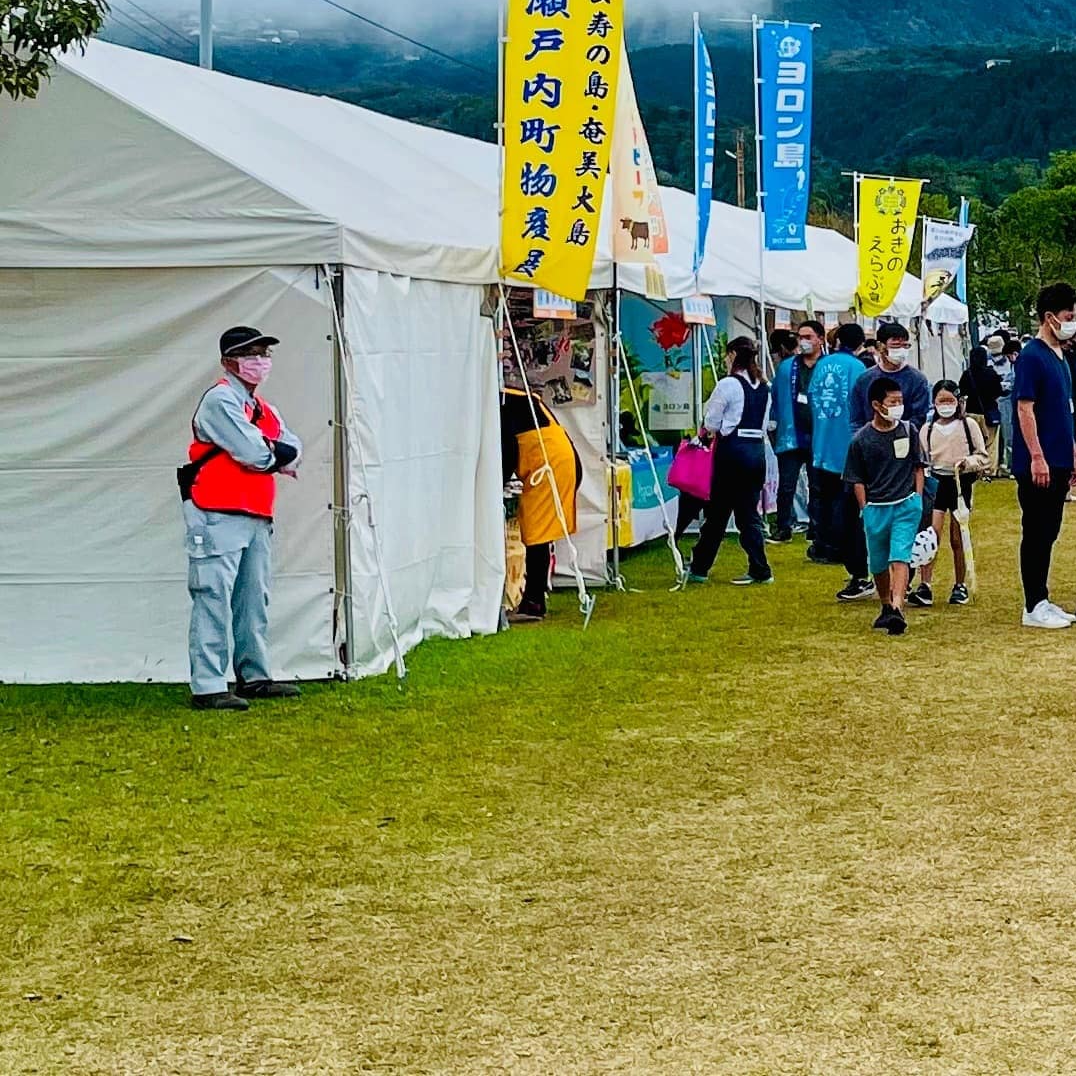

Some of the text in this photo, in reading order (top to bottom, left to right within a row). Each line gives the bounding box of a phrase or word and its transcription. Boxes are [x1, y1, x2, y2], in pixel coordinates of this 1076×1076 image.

[773, 61, 807, 169] ヨロン島
[887, 217, 908, 272] おきの
